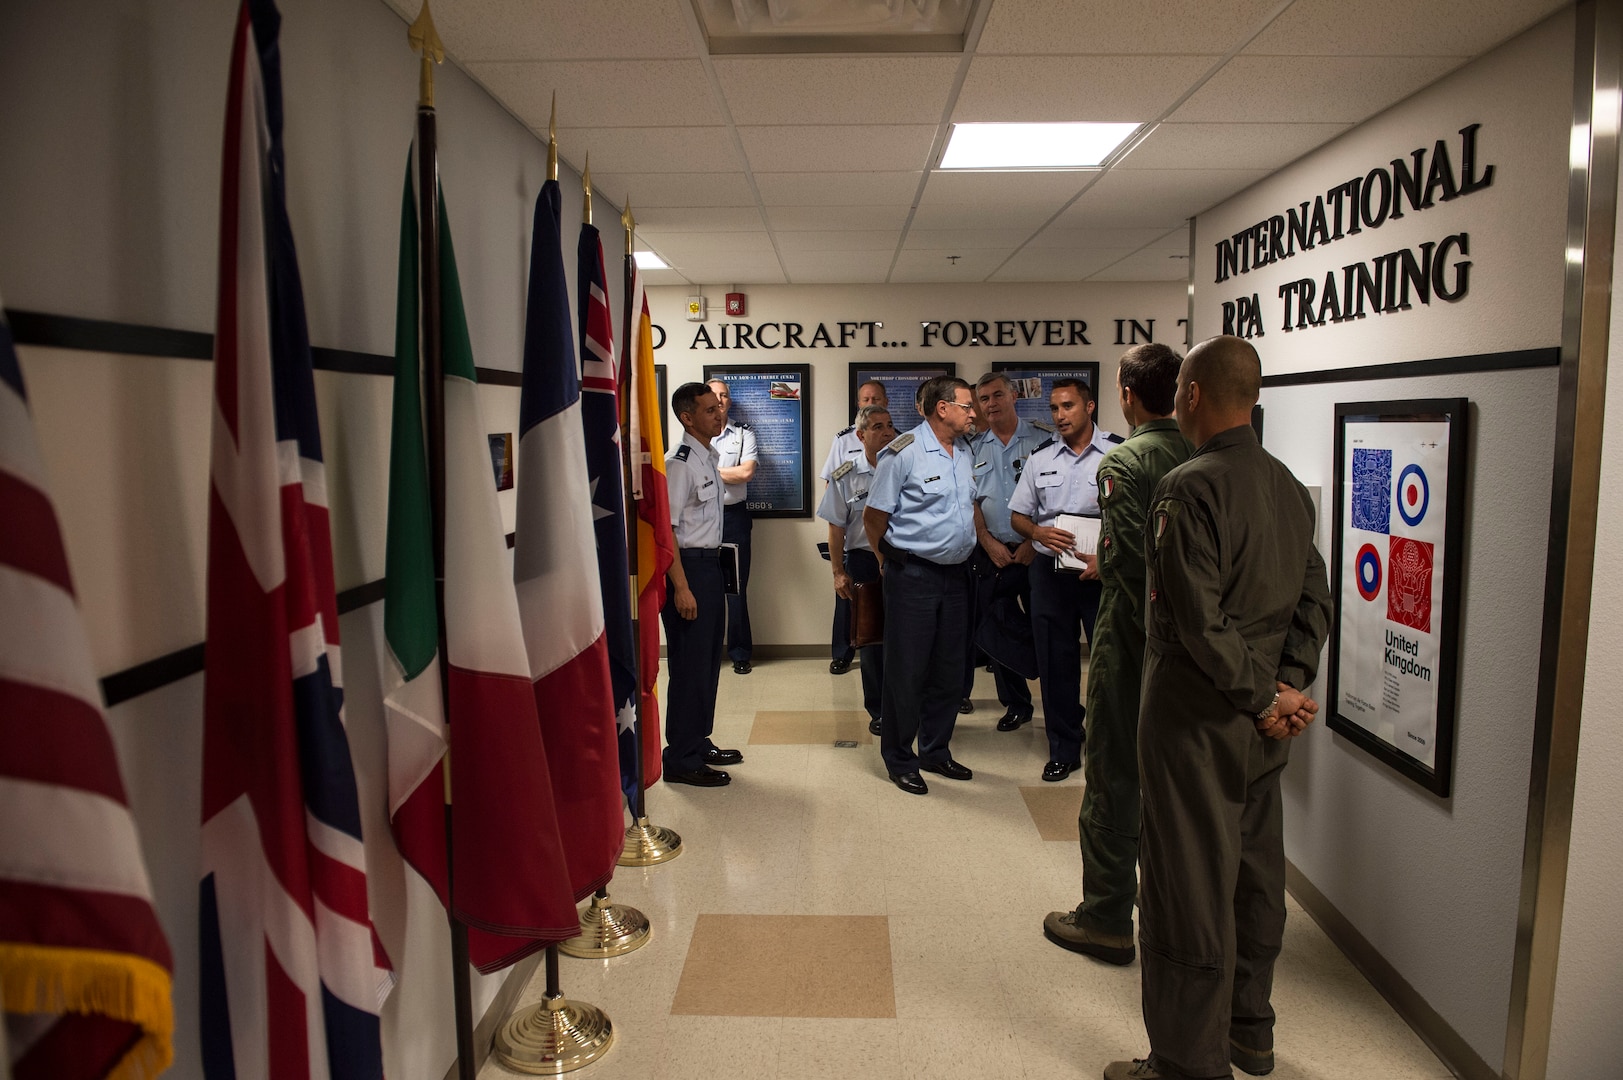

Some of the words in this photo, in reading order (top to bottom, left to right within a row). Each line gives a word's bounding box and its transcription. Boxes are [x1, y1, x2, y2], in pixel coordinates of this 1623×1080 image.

[1214, 123, 1493, 284] INTERNATIONAL
[1222, 293, 1265, 339] RPA
[1279, 232, 1472, 333] TRAINING
[690, 321, 908, 349] AIRCRAFT...
[920, 319, 1092, 348] FOREVER
[1114, 319, 1156, 345] IN
[745, 501, 773, 510] 1960's
[1385, 629, 1418, 657] United
[1385, 648, 1431, 681] Kingdom
